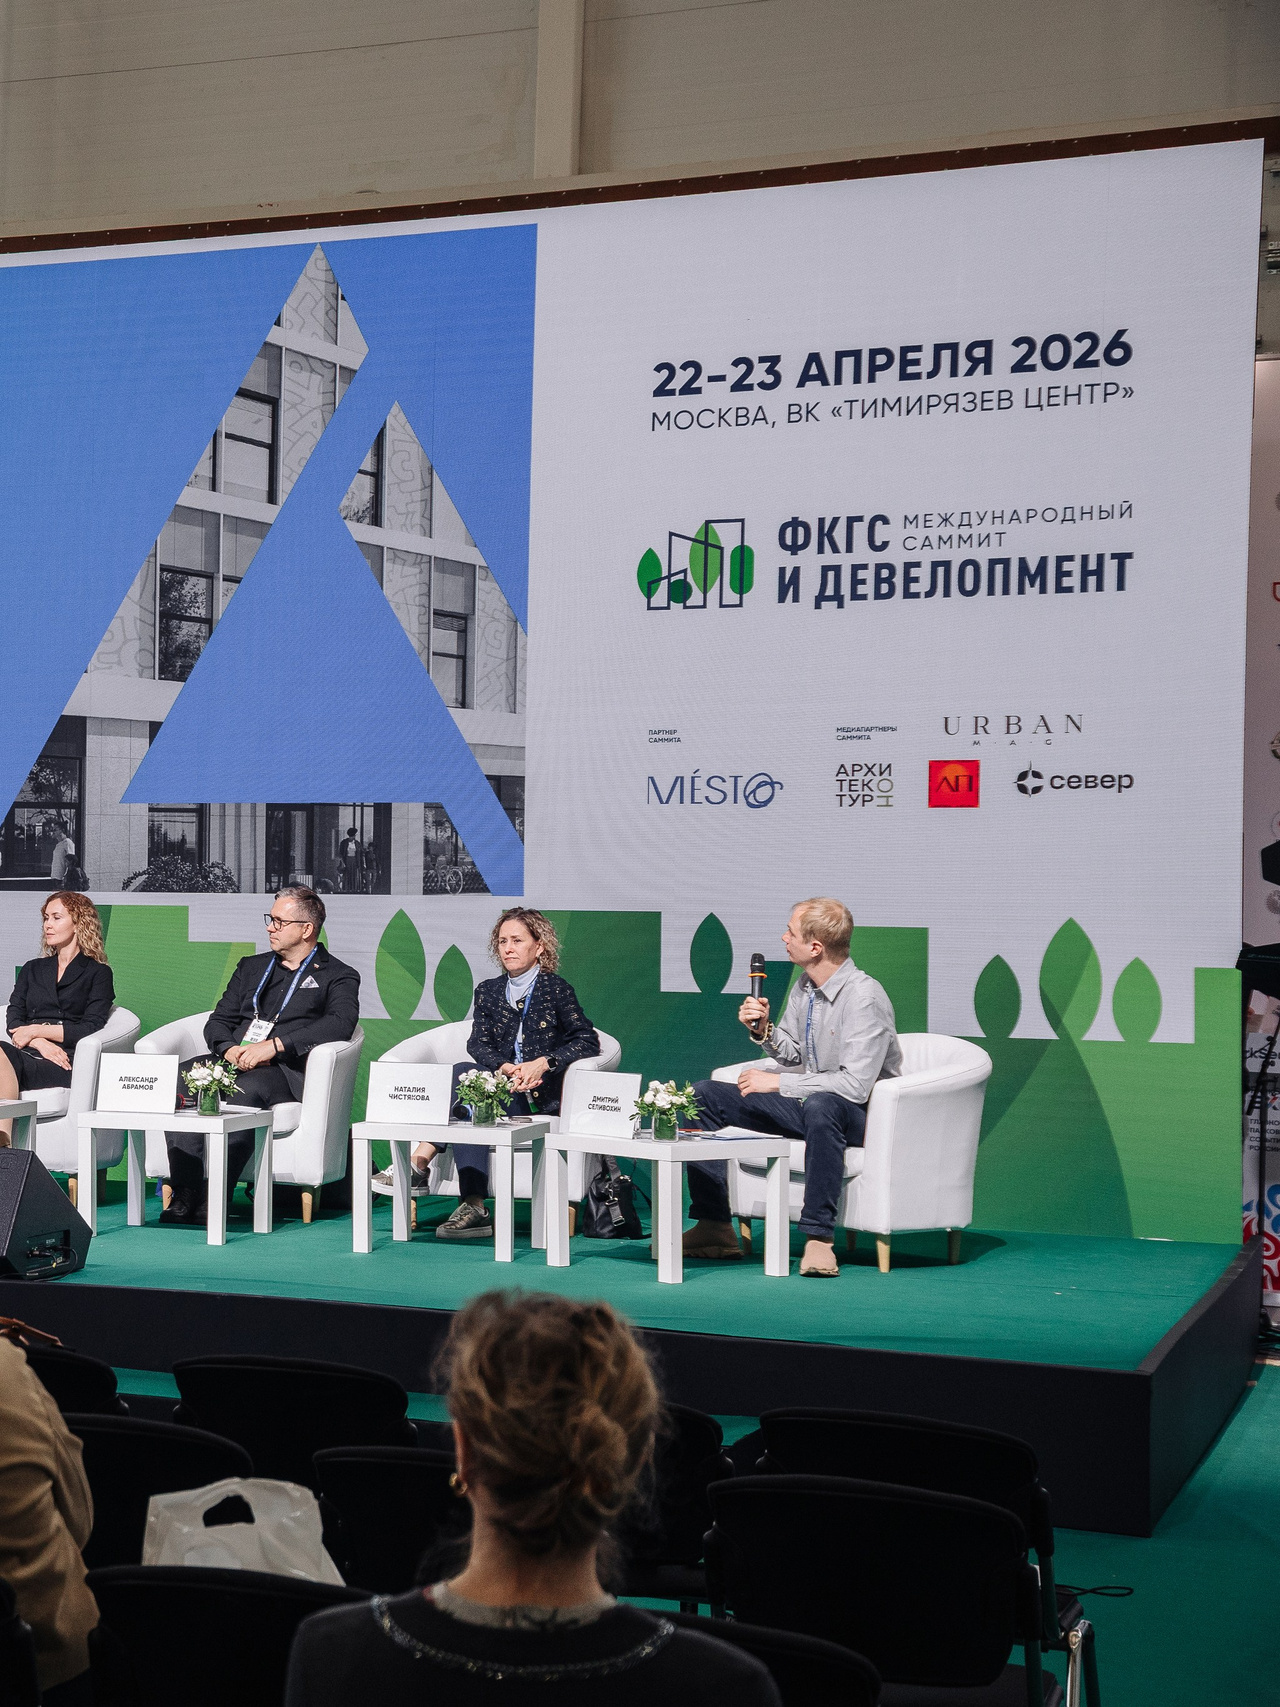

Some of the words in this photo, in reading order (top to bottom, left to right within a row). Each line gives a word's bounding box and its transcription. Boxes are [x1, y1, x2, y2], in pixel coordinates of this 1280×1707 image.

[797, 339, 994, 389] АПРЕЛЯ
[1010, 329, 1133, 374] 2026
[651, 406, 776, 431] МОСКВА,
[787, 402, 820, 424] ВК
[831, 389, 1013, 421] «ТИМИРЯЗЕВ
[1024, 381, 1134, 411] ЦЕНТР»
[903, 500, 1134, 529] МЕЖДУНАРОДНЫЙ
[777, 514, 891, 556] ФКГС
[902, 531, 1008, 551] САММИТ
[778, 566, 800, 603] И
[814, 551, 1134, 609] ДЕВЕЛОПМЕНТ
[943, 714, 1083, 736] URBAN
[835, 763, 892, 777] АРХИ
[1050, 774, 1134, 794] север
[118, 1076, 158, 1084] АЛЕКСАНДР
[588, 1104, 621, 1112] СЕЛИВОХИН
[592, 1095, 619, 1104] ДМИТРИЙ
